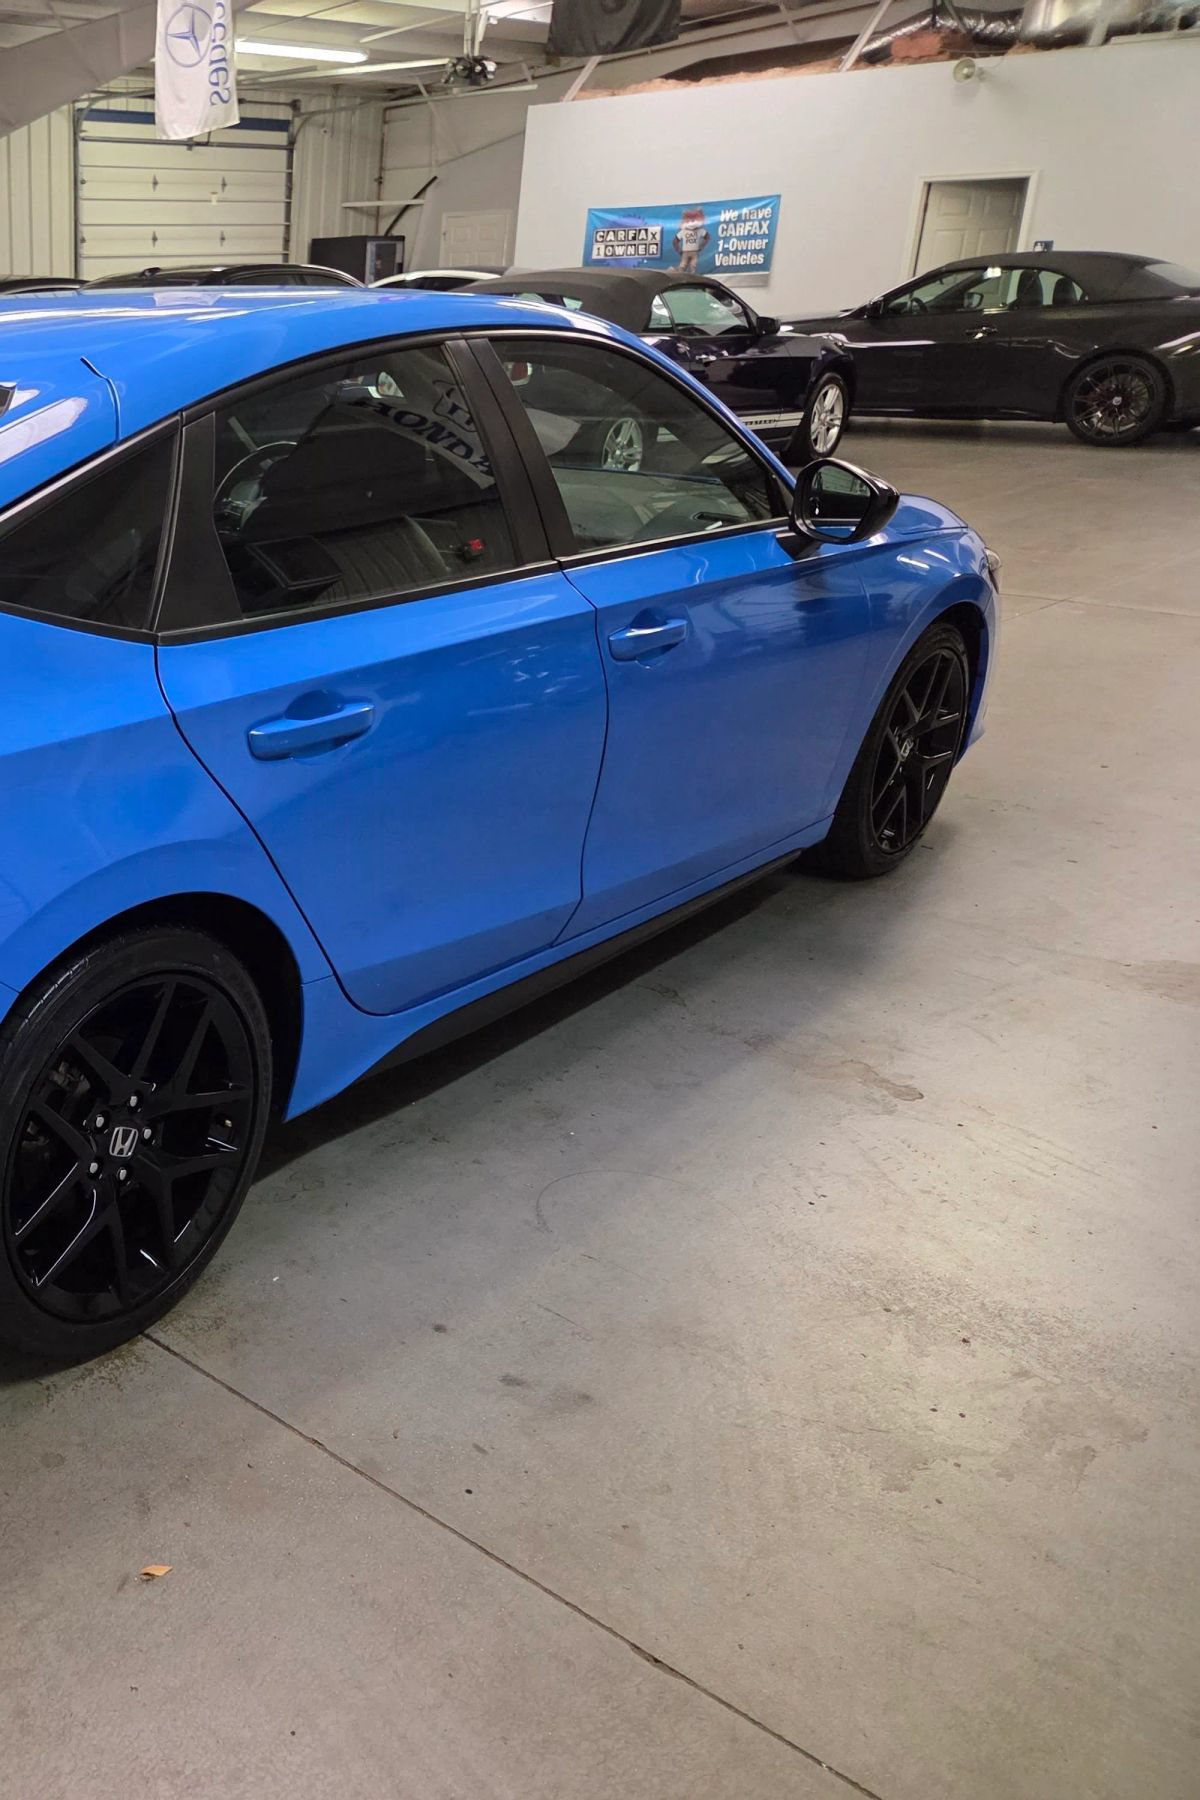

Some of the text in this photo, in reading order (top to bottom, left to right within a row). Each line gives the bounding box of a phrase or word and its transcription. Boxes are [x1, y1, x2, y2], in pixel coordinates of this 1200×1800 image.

[720, 207, 772, 222] We have
[595, 228, 658, 242] CARFAX
[718, 220, 770, 238] CARFAX
[717, 238, 768, 252] 1-Owner
[715, 251, 765, 267] Vehicles
[347, 398, 495, 478] HONDA
